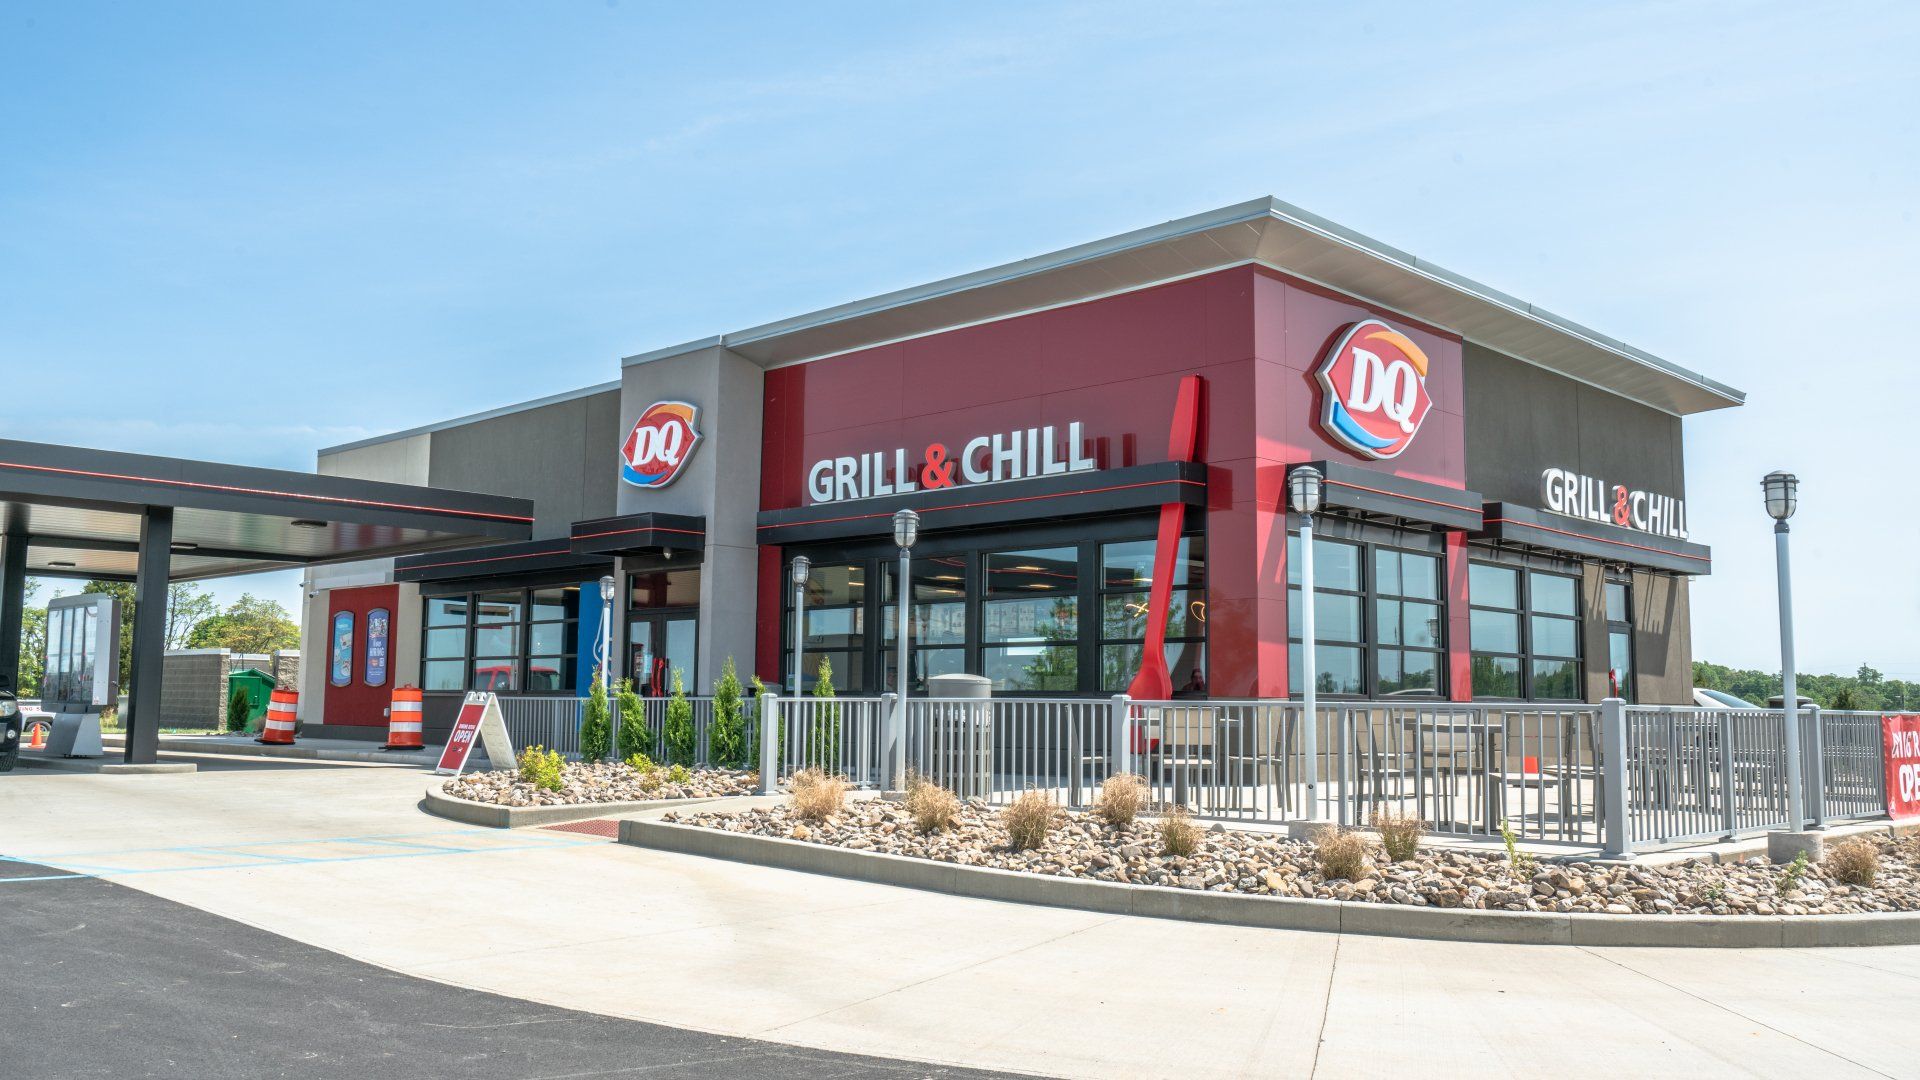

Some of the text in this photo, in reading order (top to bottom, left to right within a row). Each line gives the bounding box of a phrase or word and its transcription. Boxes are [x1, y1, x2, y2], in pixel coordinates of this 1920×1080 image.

[1347, 346, 1418, 434] DQ
[632, 420, 683, 467] DQ
[808, 421, 1095, 502] GRILL & CHILL
[1542, 468, 1689, 540] GRILL & CHILL
[453, 730, 474, 744] OPEN
